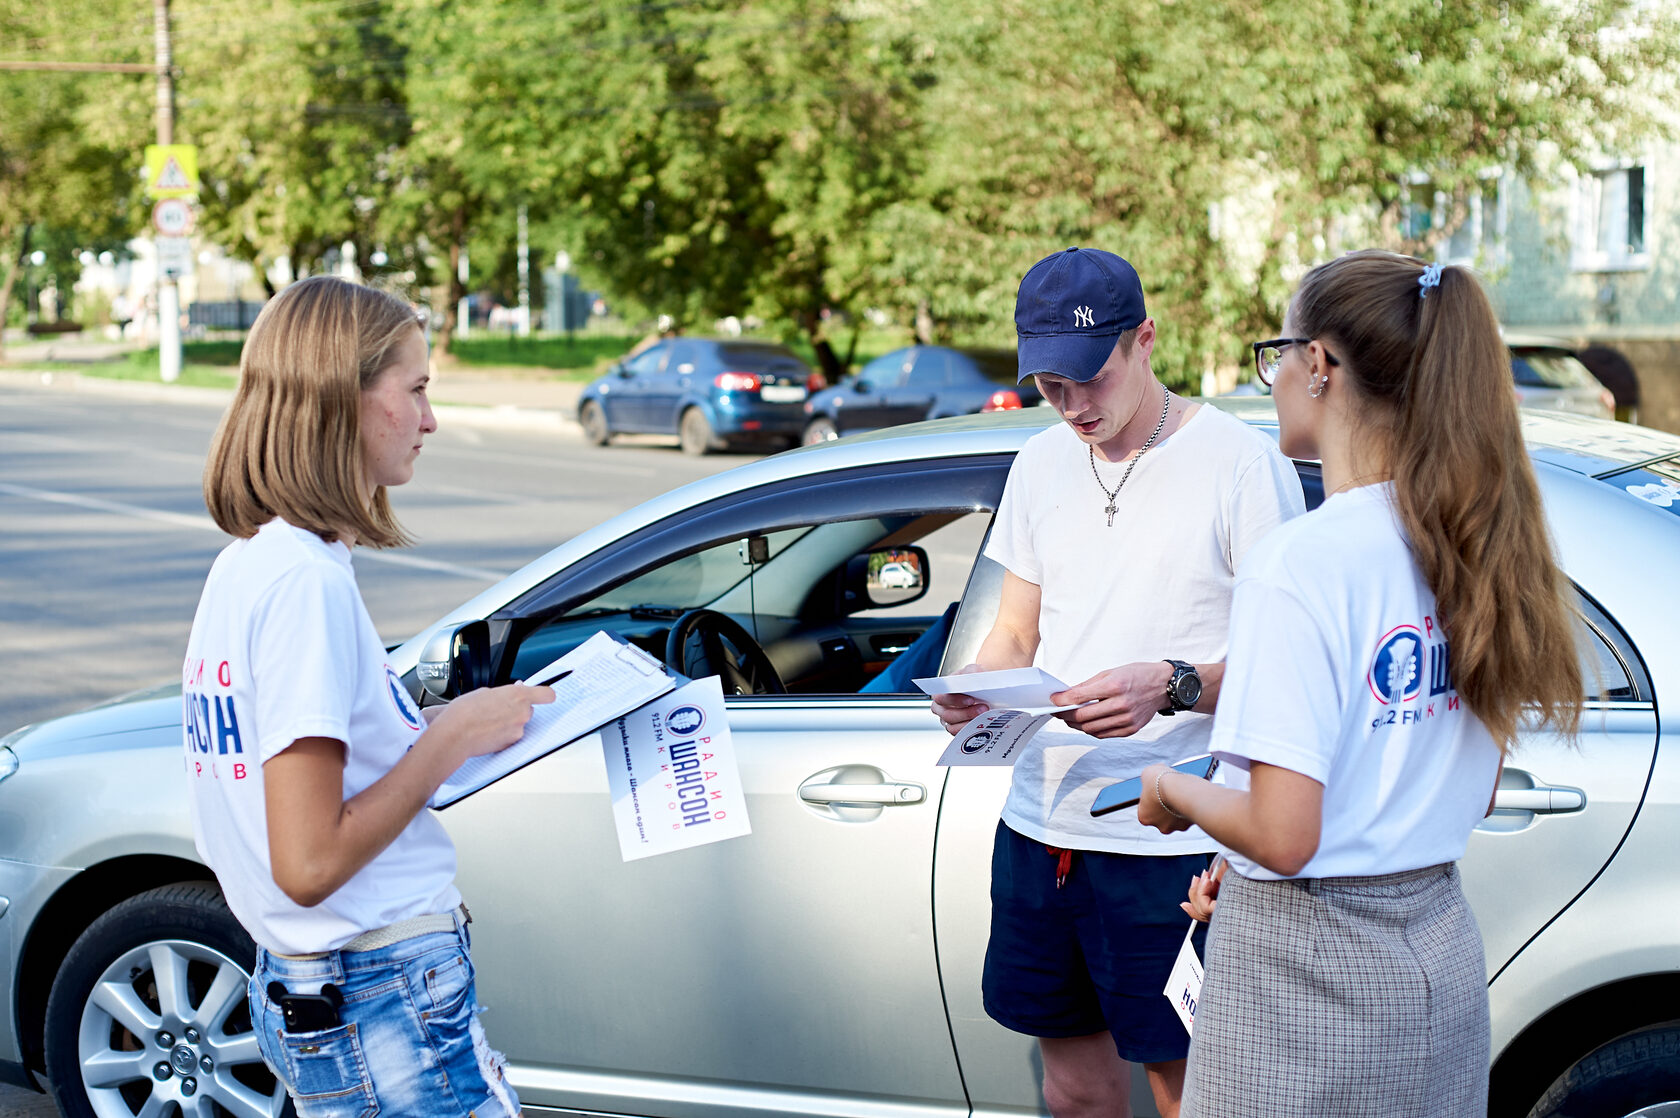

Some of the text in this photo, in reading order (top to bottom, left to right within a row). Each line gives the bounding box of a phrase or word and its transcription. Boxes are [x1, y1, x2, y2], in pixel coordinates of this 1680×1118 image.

[1402, 709, 1422, 725] FM
[617, 717, 629, 746] узыки
[629, 778, 640, 813] Шансон
[652, 712, 681, 830] 91.2 FM КИРОВ
[669, 740, 711, 827] ШАНСОН
[699, 736, 726, 820] РАДИО
